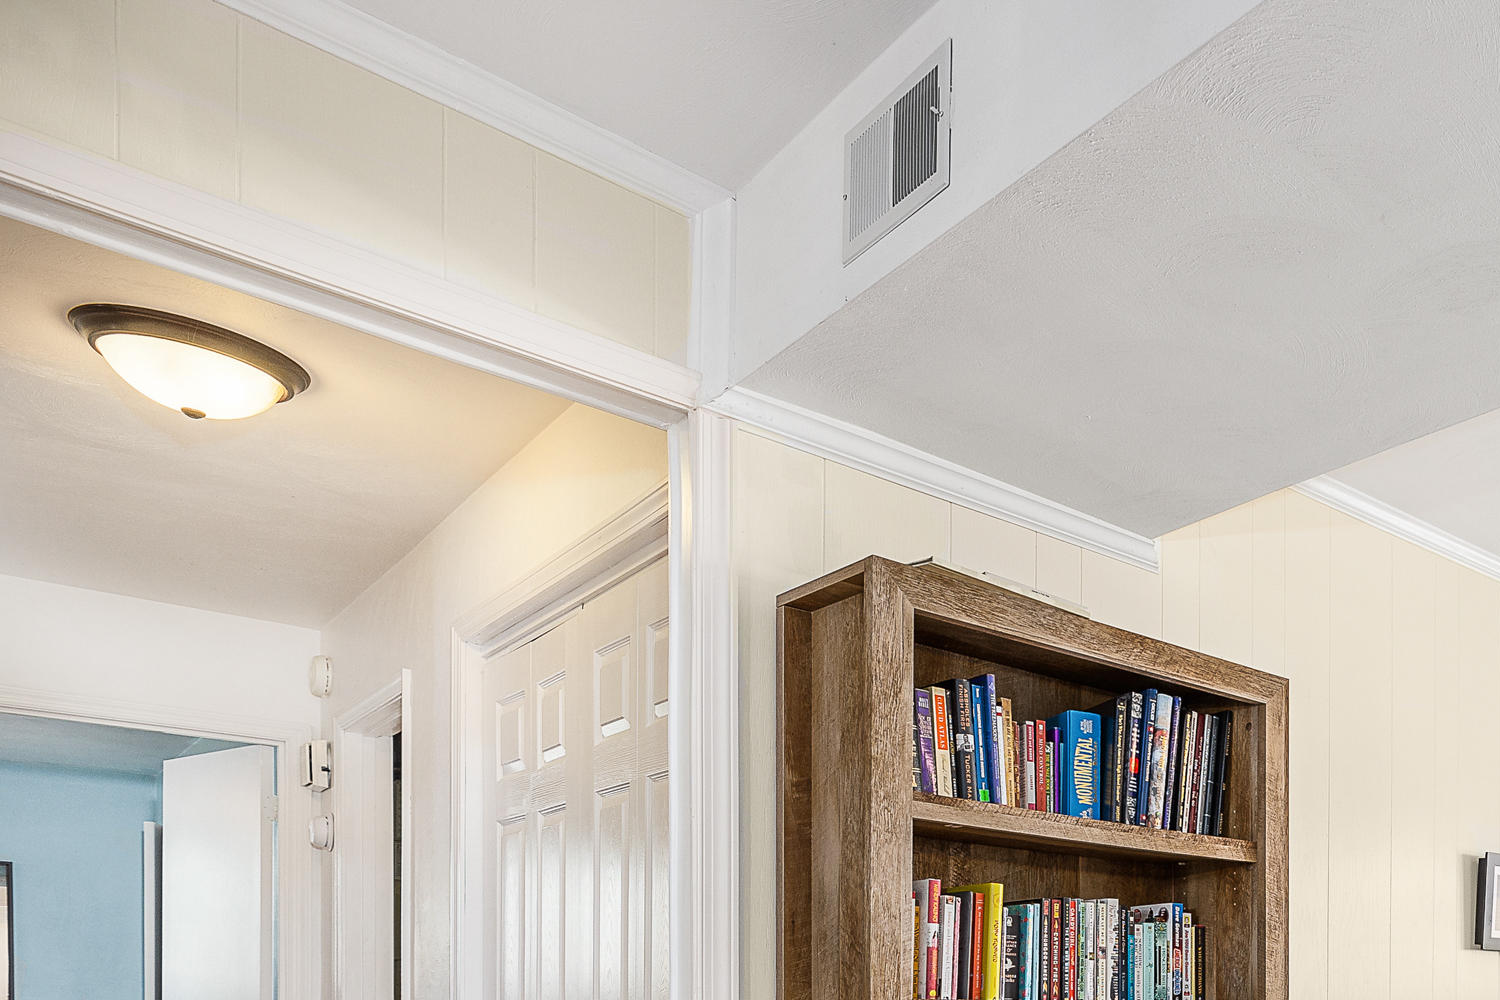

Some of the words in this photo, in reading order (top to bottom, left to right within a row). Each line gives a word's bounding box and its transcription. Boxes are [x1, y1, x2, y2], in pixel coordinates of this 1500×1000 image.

[936, 697, 944, 723] CLOUD
[963, 688, 971, 727] ASSHOLES
[938, 724, 946, 748] ATLAS
[1074, 738, 1095, 805] MONUMENTAL
